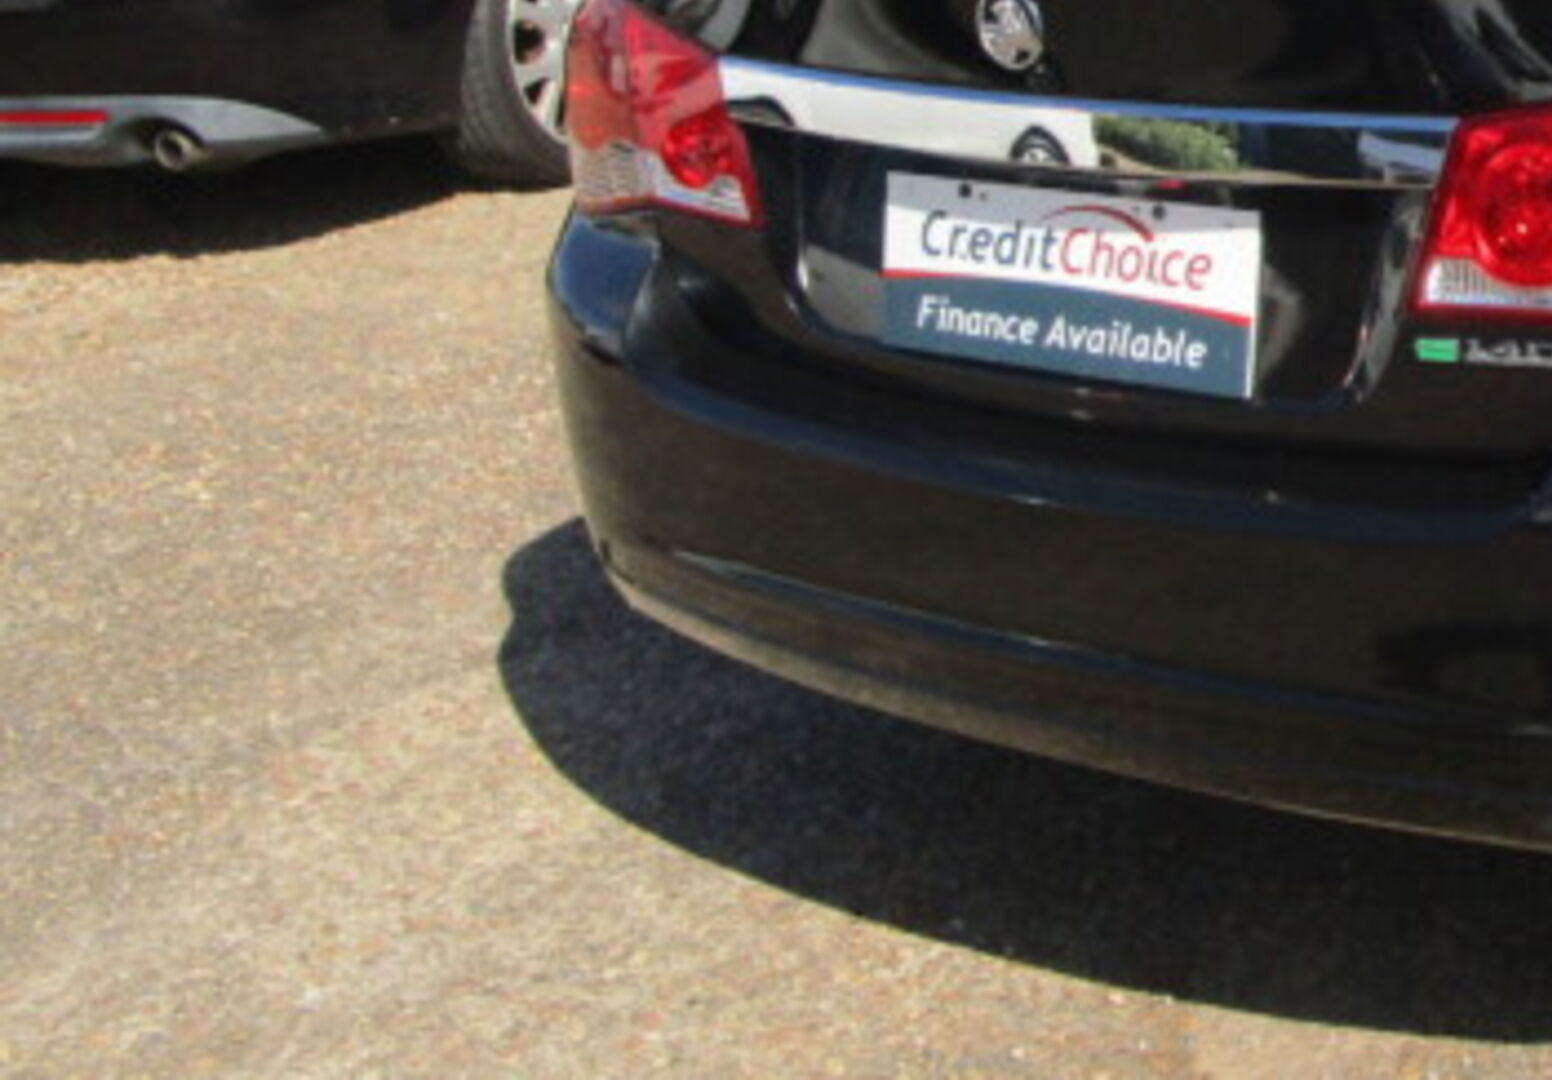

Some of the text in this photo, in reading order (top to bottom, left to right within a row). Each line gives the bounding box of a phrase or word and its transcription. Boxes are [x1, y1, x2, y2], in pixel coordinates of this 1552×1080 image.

[920, 209, 1213, 291] CreditChoice
[916, 294, 1208, 369] Finance Available
